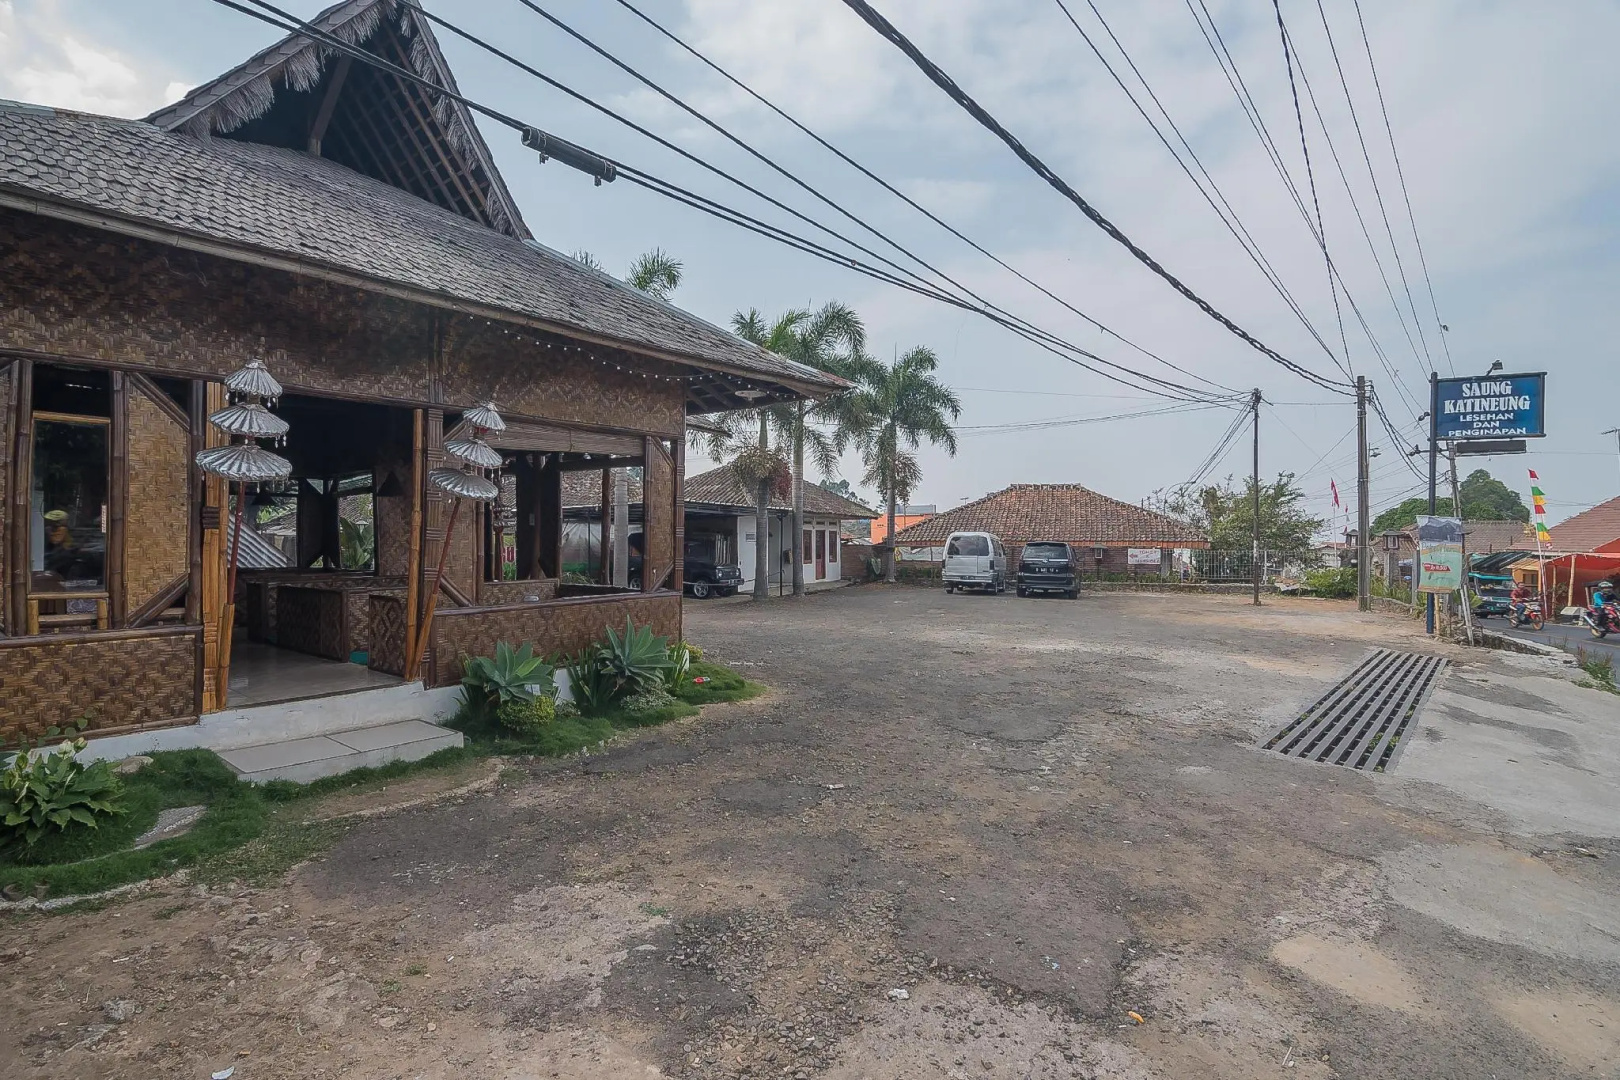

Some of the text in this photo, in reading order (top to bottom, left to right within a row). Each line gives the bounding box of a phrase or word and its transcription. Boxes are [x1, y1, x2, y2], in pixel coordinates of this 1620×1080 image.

[1462, 381, 1512, 397] SAUNG
[1444, 395, 1531, 414] KATINEUNG
[1460, 413, 1514, 422] LESEHAN
[1448, 427, 1527, 437] PENGINAPAN
